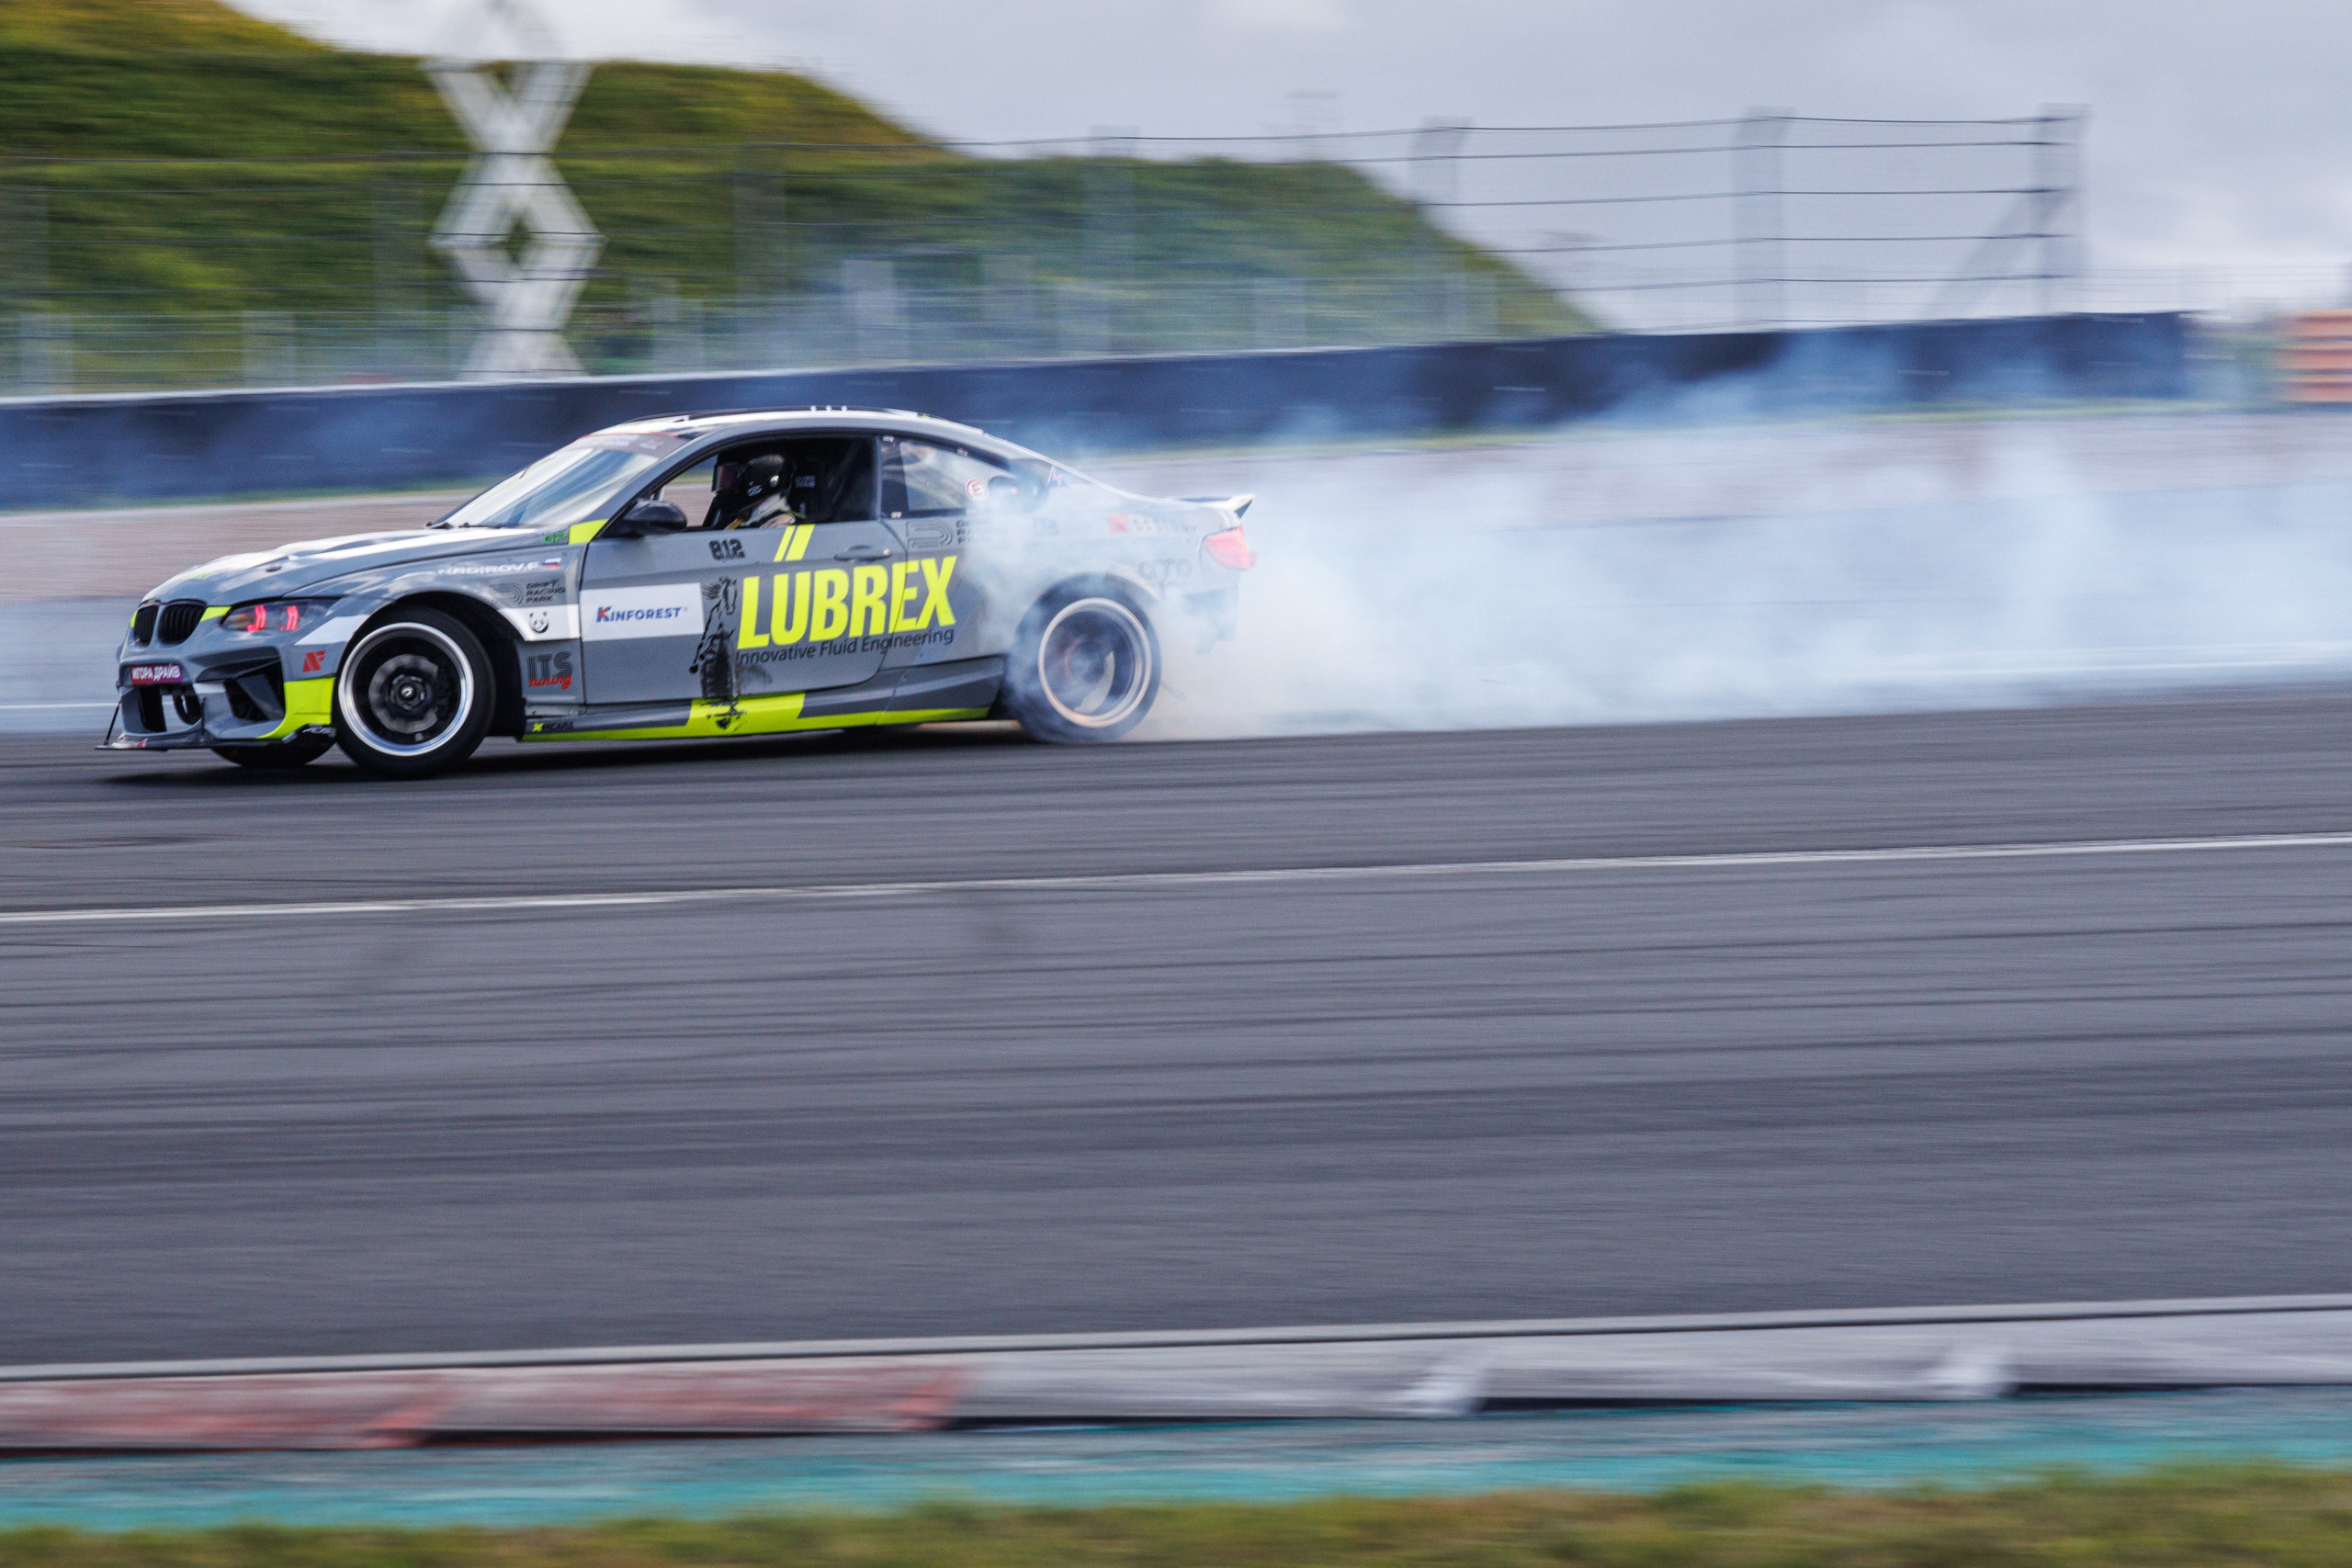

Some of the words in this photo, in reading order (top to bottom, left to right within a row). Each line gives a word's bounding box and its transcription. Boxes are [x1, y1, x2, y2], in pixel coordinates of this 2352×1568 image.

[737, 556, 957, 649] LUBREX
[737, 647, 816, 666] Innovative
[820, 637, 857, 656] Fluid
[861, 628, 955, 655] Engineering
[527, 651, 572, 680] ITS
[528, 674, 572, 691] tuning
